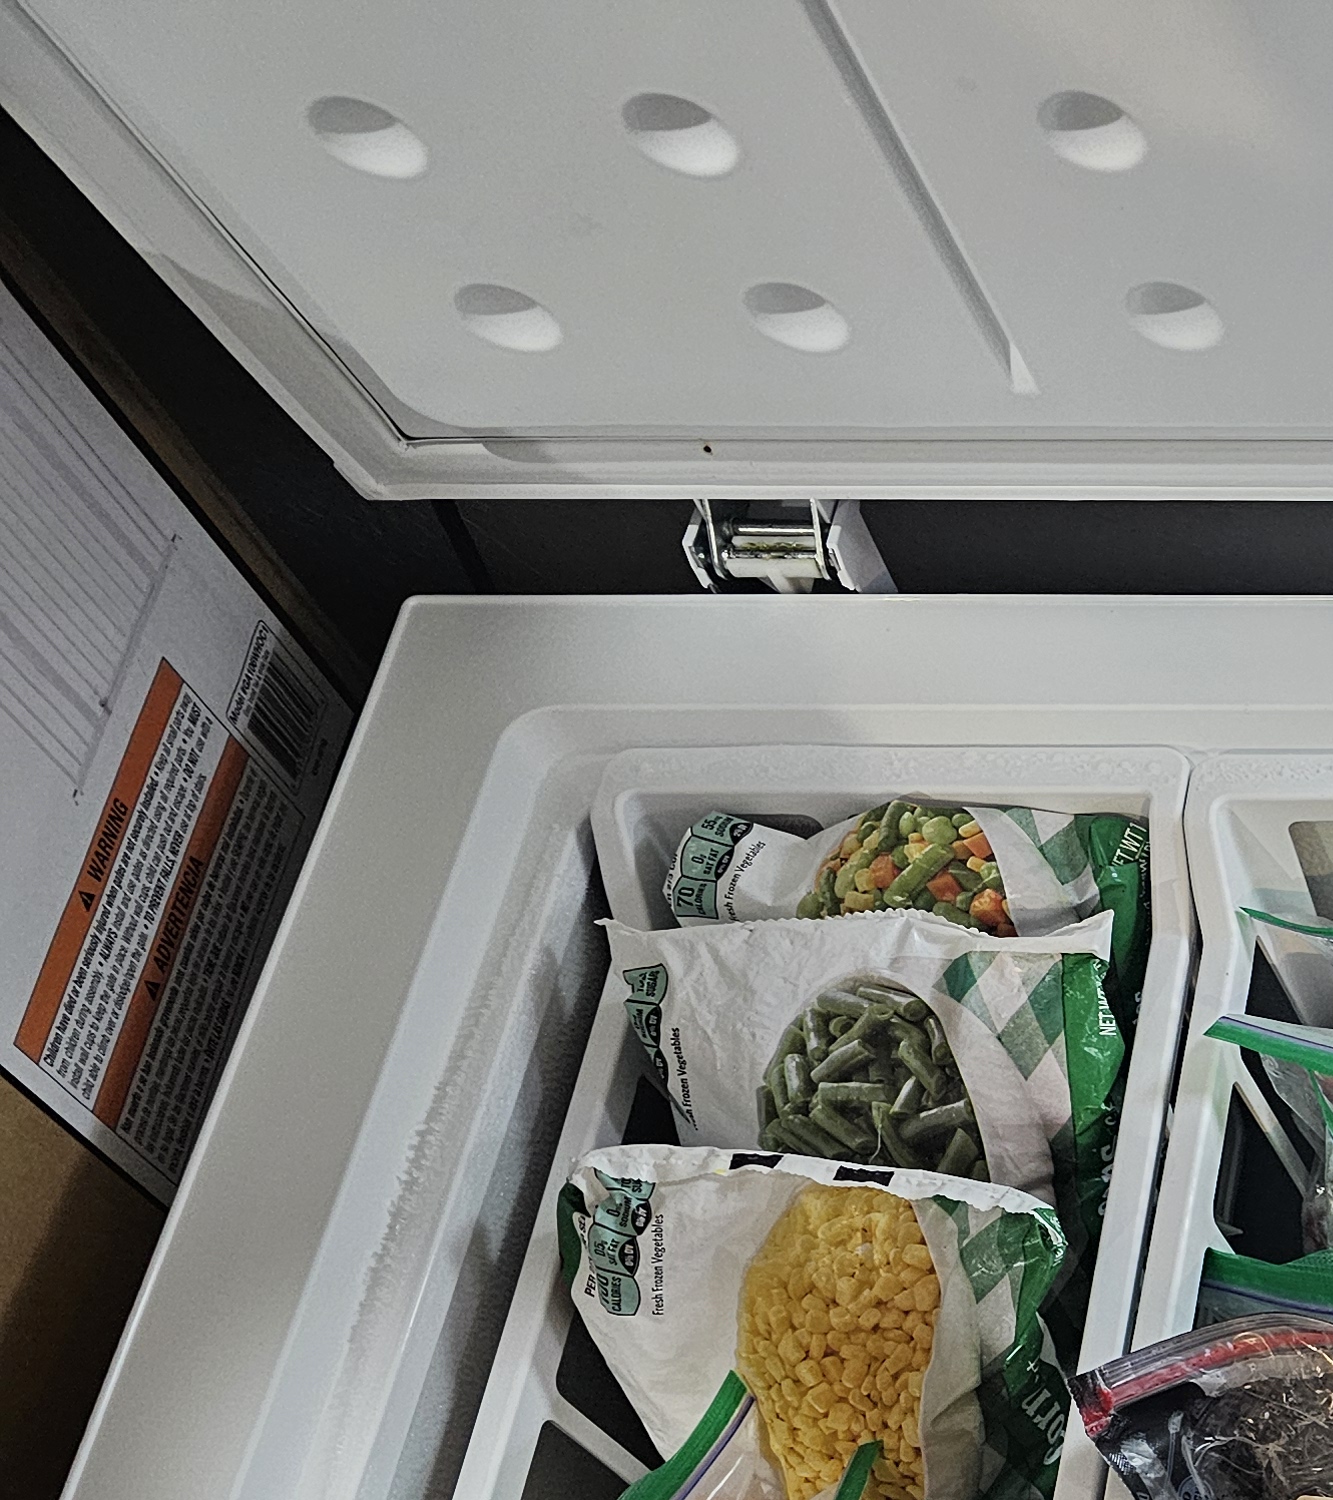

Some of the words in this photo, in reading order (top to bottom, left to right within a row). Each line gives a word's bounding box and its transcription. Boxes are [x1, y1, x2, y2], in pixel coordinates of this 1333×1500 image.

[228, 692, 244, 724] Model
[187, 747, 199, 767] NOT
[183, 763, 194, 778] DO
[87, 798, 127, 881] WARNING
[1119, 828, 1143, 852] WT
[706, 848, 719, 861] FAT
[64, 1027, 80, 1059] children
[74, 1003, 91, 1029] during
[99, 927, 117, 961] ALWAYS
[187, 702, 201, 726] MUST
[147, 877, 165, 914] PREVENT
[168, 830, 183, 857] NEVER
[724, 873, 741, 900] Frozen
[735, 841, 766, 874] Vegetables
[105, 885, 118, 908] when
[677, 887, 695, 908] 70
[93, 904, 110, 934] injured
[154, 856, 203, 973] ADVERTENCIA
[82, 932, 101, 969] seriously
[72, 966, 87, 988] been
[70, 985, 80, 997] or
[63, 993, 76, 1015] died
[92, 1002, 106, 1022] keep
[55, 1013, 70, 1034] have
[1098, 1011, 1117, 1036] NET
[43, 1032, 62, 1066] Children
[83, 1029, 96, 1050] cups
[670, 1028, 687, 1077] Vegetables
[679, 1079, 692, 1107] Frozen
[619, 1196, 632, 1228] SODIUM
[609, 1238, 620, 1251] FAT
[651, 1214, 665, 1264] Vegetables
[584, 1273, 598, 1298] PER
[610, 1276, 622, 1307] CALORIES
[651, 1266, 664, 1292] Frozen
[651, 1294, 664, 1316] Fresh
